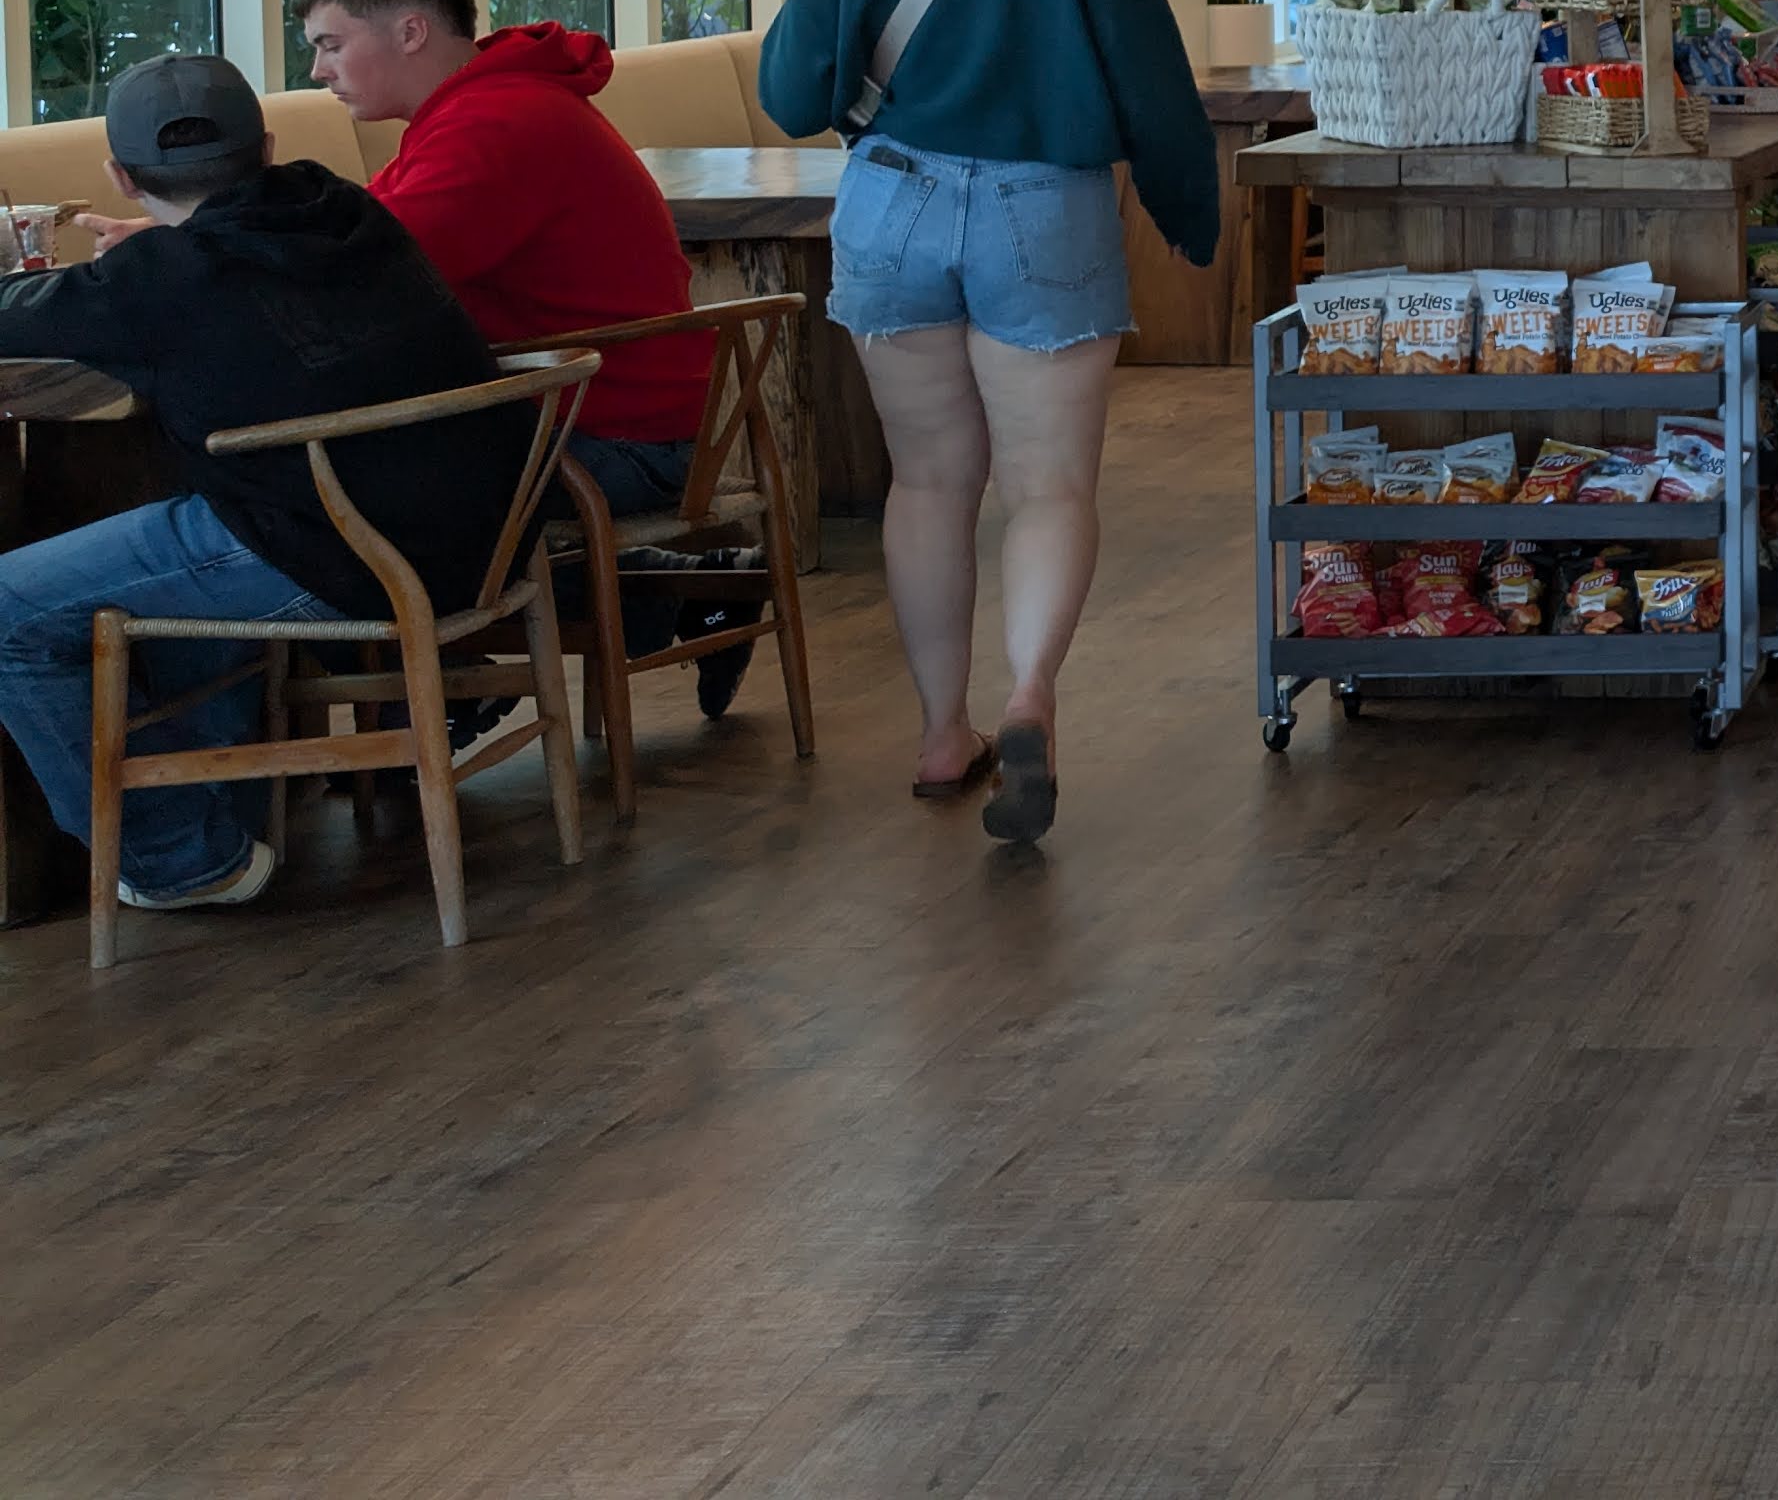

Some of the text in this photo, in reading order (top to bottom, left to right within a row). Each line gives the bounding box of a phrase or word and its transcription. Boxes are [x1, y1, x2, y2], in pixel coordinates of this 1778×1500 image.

[1314, 296, 1370, 320] Uglies
[1398, 293, 1452, 317] Uglies
[1493, 287, 1550, 309] Uglies
[1589, 291, 1646, 314] Uglies
[1321, 561, 1359, 582] Sun
[1420, 554, 1457, 572] Sun
